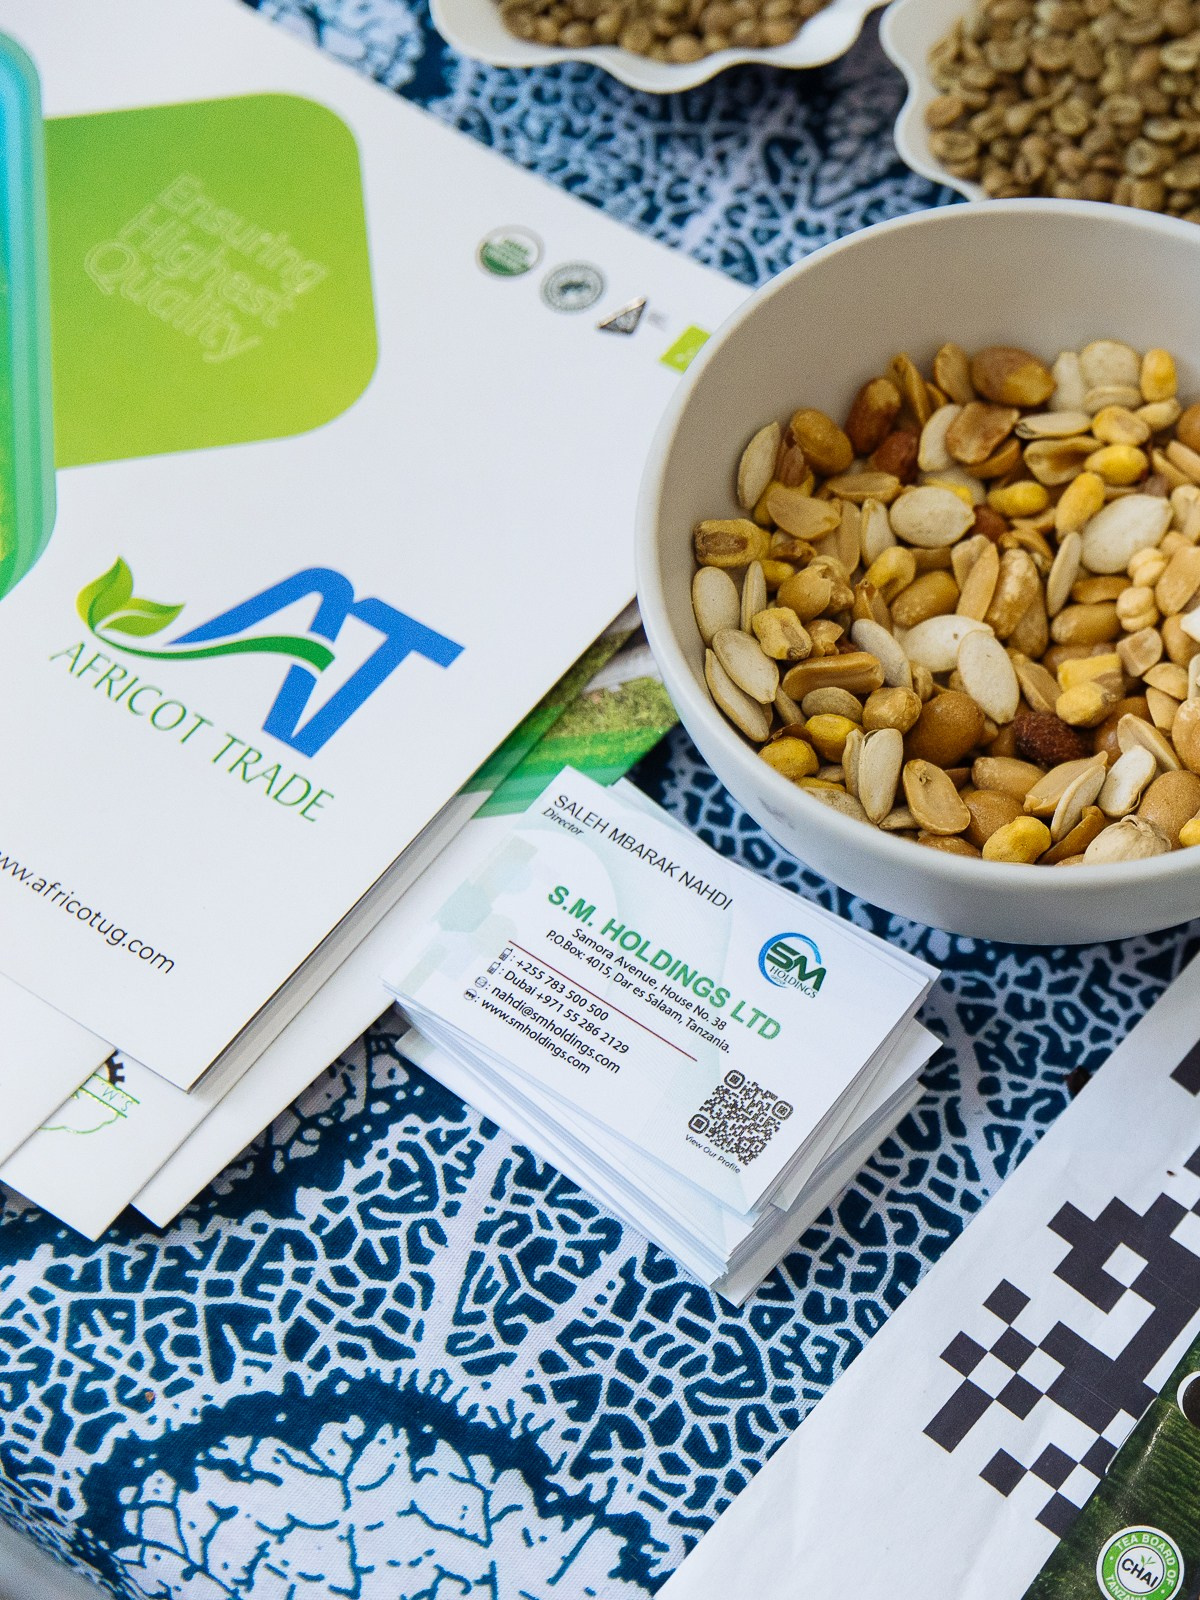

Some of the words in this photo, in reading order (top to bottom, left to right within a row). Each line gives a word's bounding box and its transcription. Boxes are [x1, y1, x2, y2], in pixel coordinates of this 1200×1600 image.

[117, 203, 295, 328] Highest
[156, 172, 328, 294] Ensuring
[84, 241, 262, 363] Quality
[49, 641, 214, 744] AFRICOT
[211, 733, 335, 822] TRADE
[541, 807, 585, 836] Director
[554, 794, 610, 834] SALEH
[608, 827, 681, 877] MBARAK
[678, 871, 734, 911] NAHDI
[0, 852, 175, 974] ww.africotug.com
[516, 960, 546, 981] +255
[545, 975, 566, 994] 783
[565, 989, 588, 1007] 500
[586, 1003, 609, 1021] 500
[546, 929, 586, 960] P.O.Box:
[586, 955, 612, 979] 4015,
[613, 972, 633, 990] Dar
[632, 985, 646, 998] es
[645, 993, 683, 1024] Salaam,
[684, 1017, 730, 1054] Tanzania.
[547, 885, 596, 927] S.M.
[600, 918, 731, 1008] HOLDINGS
[730, 1000, 781, 1041] LTD
[572, 928, 614, 960] Samora
[613, 956, 658, 989] Avenue,
[660, 984, 693, 1010] House
[692, 1004, 710, 1022] No.
[711, 1017, 727, 1031] 38
[766, 941, 827, 992] SM
[769, 965, 818, 999] HOLDINGS
[481, 999, 591, 1074] www.smholdings.com
[491, 986, 621, 1074] nahdi@smholdings.com
[504, 970, 538, 996] Dubai
[536, 992, 564, 1013] +971
[563, 1008, 581, 1023] 55
[578, 1017, 601, 1037] 286
[600, 1032, 630, 1055] 2129
[685, 1134, 703, 1149] View
[703, 1146, 717, 1158] Our
[717, 1155, 741, 1174] Profile
[1114, 1534, 1138, 1551] TEA
[1141, 1534, 1176, 1566] BOARD
[1166, 1569, 1177, 1587] OF
[1121, 1558, 1159, 1588] CHAI
